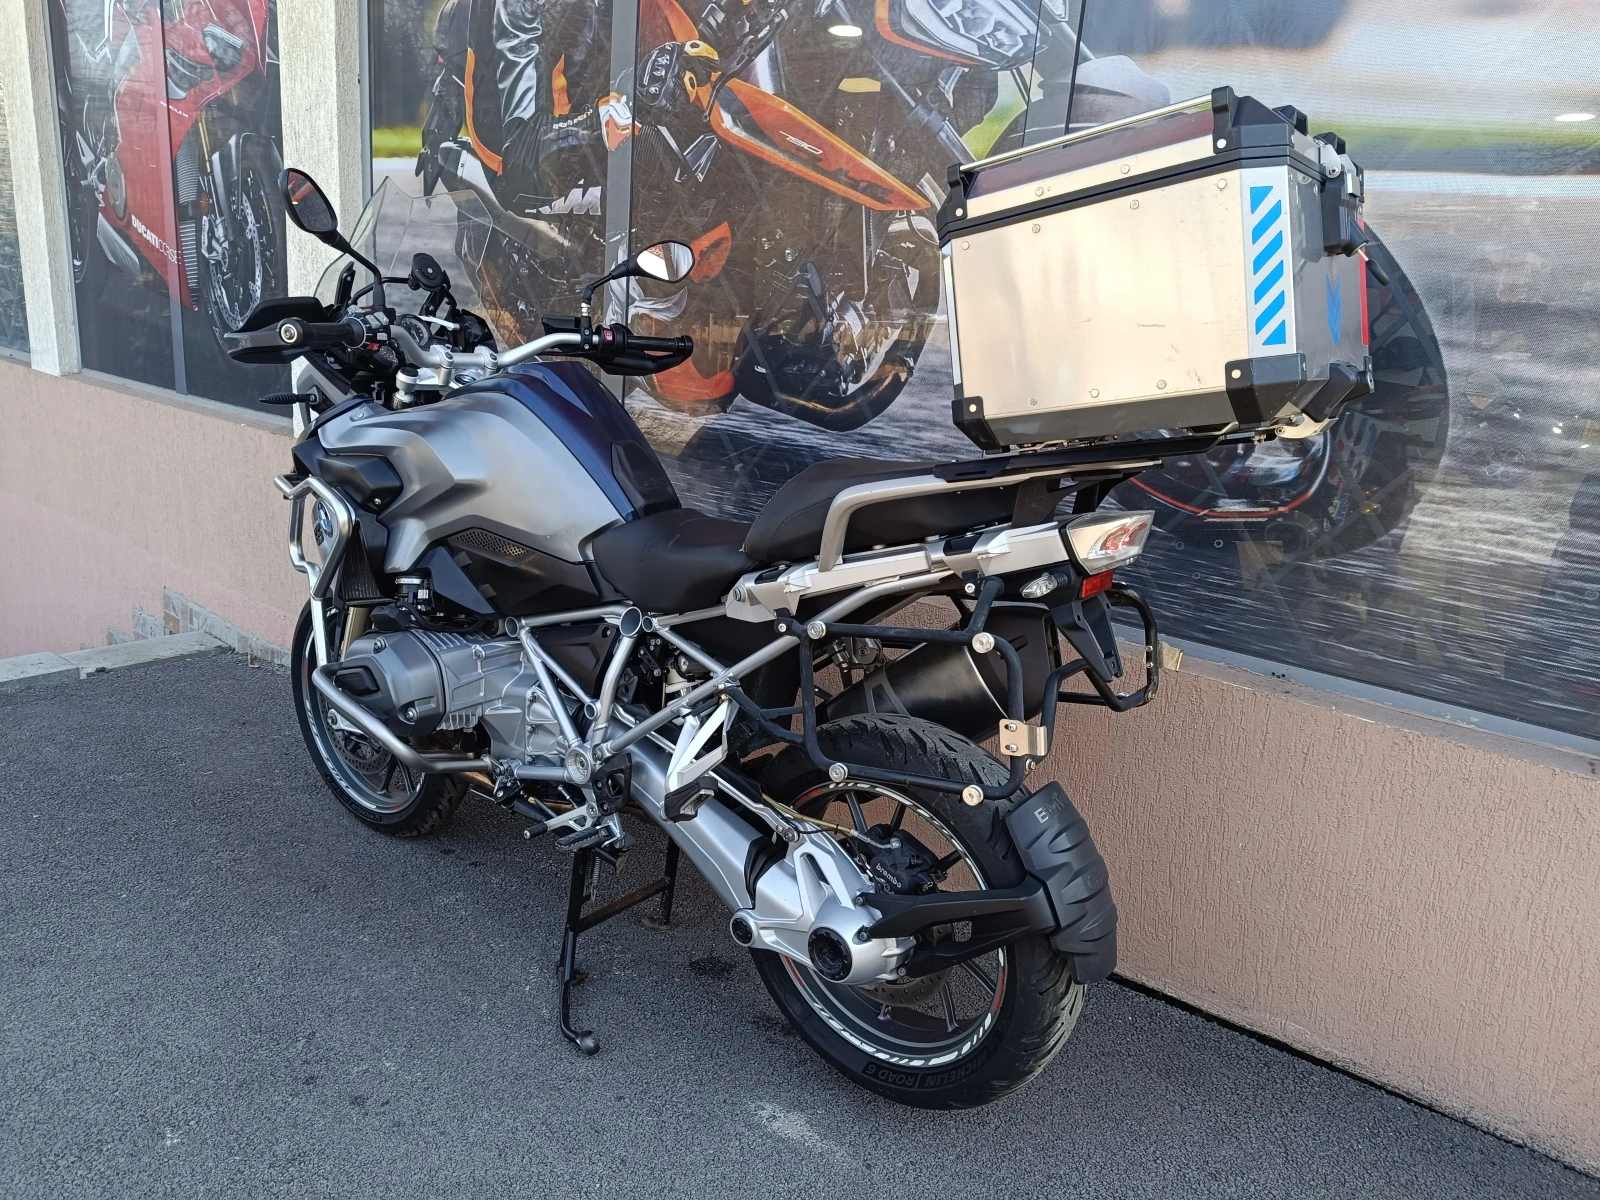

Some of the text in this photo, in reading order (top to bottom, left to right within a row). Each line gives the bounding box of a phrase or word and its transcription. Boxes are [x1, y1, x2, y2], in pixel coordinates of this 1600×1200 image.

[131, 214, 159, 249] DUCATI
[875, 862, 902, 889] brembo
[865, 1050, 988, 1088] MICHELIN ROAD 6
